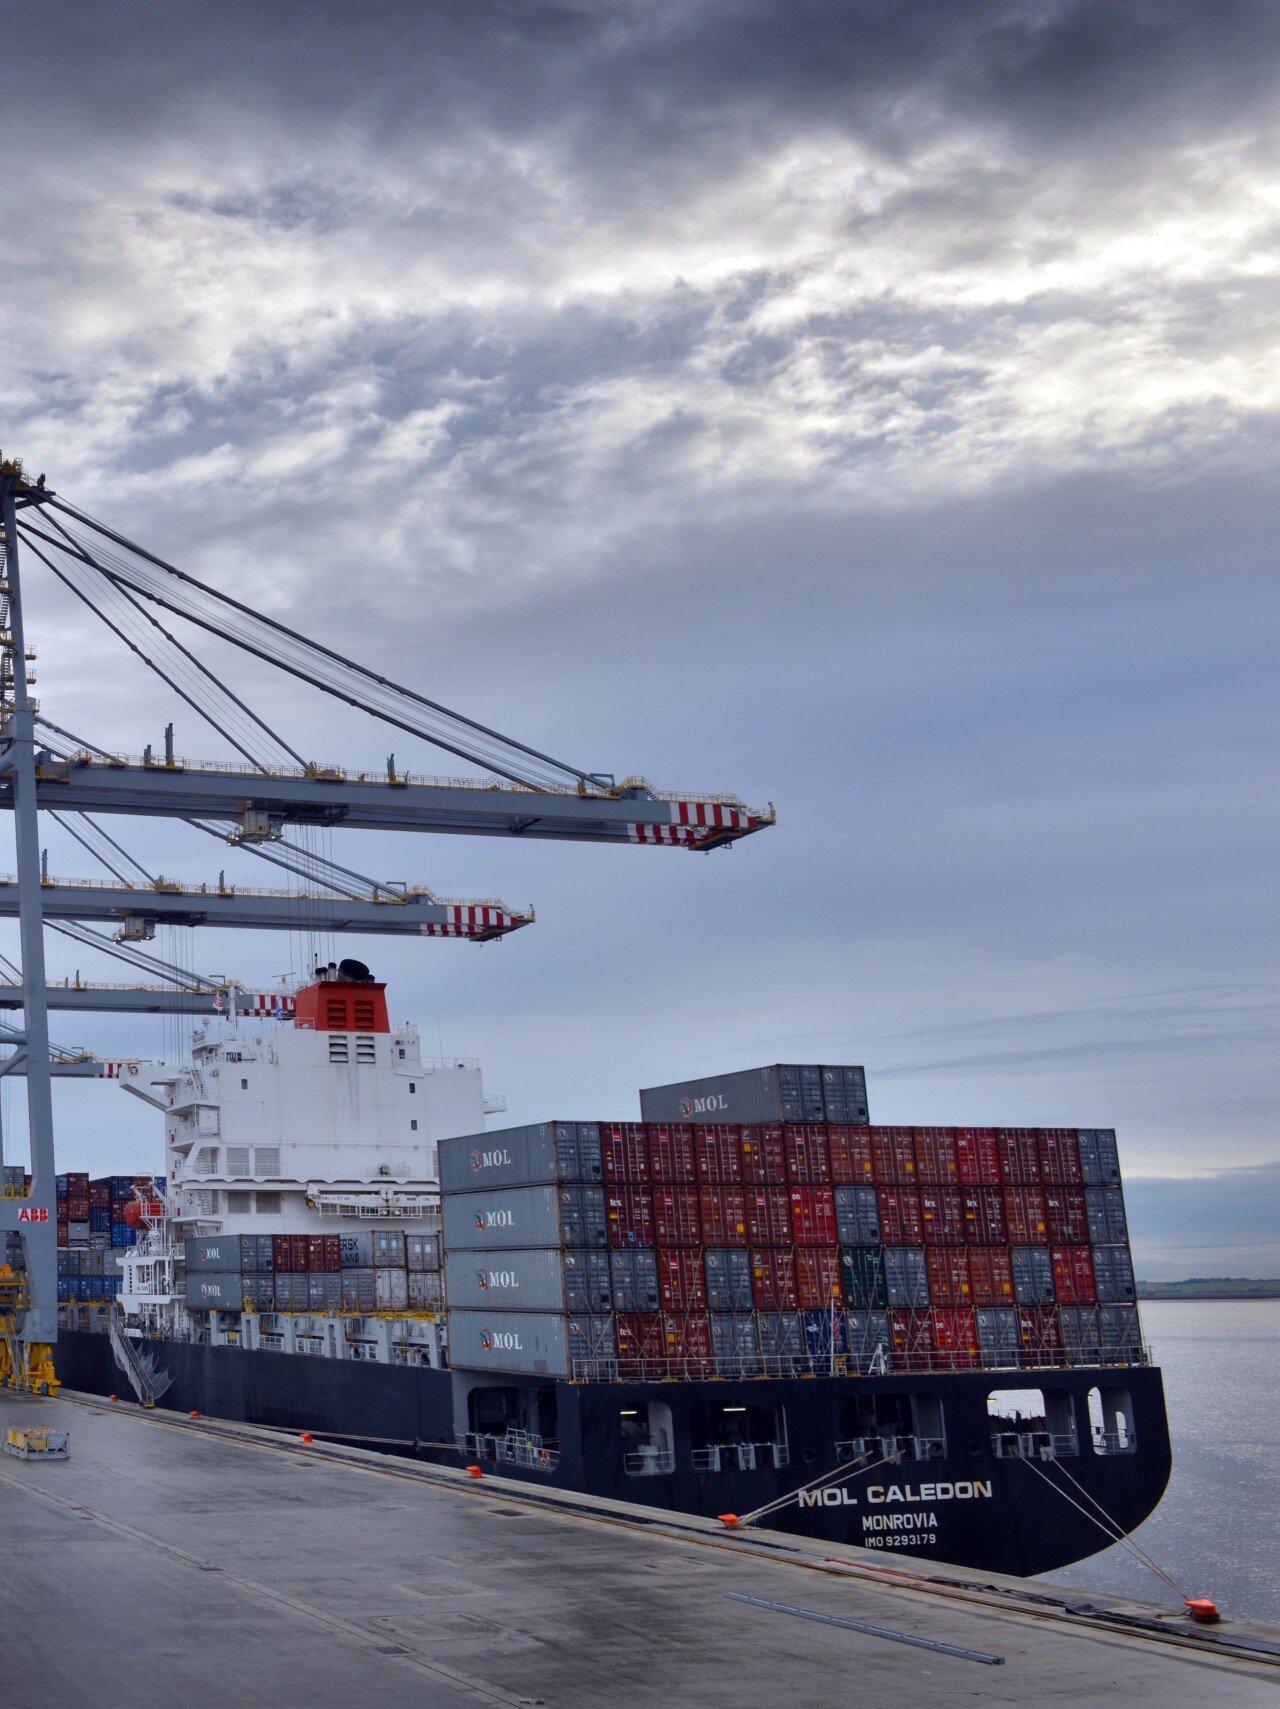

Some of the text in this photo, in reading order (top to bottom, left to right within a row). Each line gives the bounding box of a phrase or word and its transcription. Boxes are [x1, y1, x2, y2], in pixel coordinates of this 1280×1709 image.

[694, 1094, 728, 1113] MOL
[482, 1149, 512, 1167] MOL
[610, 1198, 622, 1206] tex
[18, 1208, 49, 1221] ABB
[486, 1210, 516, 1227] MOL
[489, 1270, 519, 1288] MOL
[620, 1327, 632, 1336] tex
[493, 1332, 523, 1350] MOL
[797, 1480, 993, 1508] MOL CALEDON
[862, 1512, 938, 1531] MONROVIA
[865, 1533, 937, 1548] IMO 9293179
